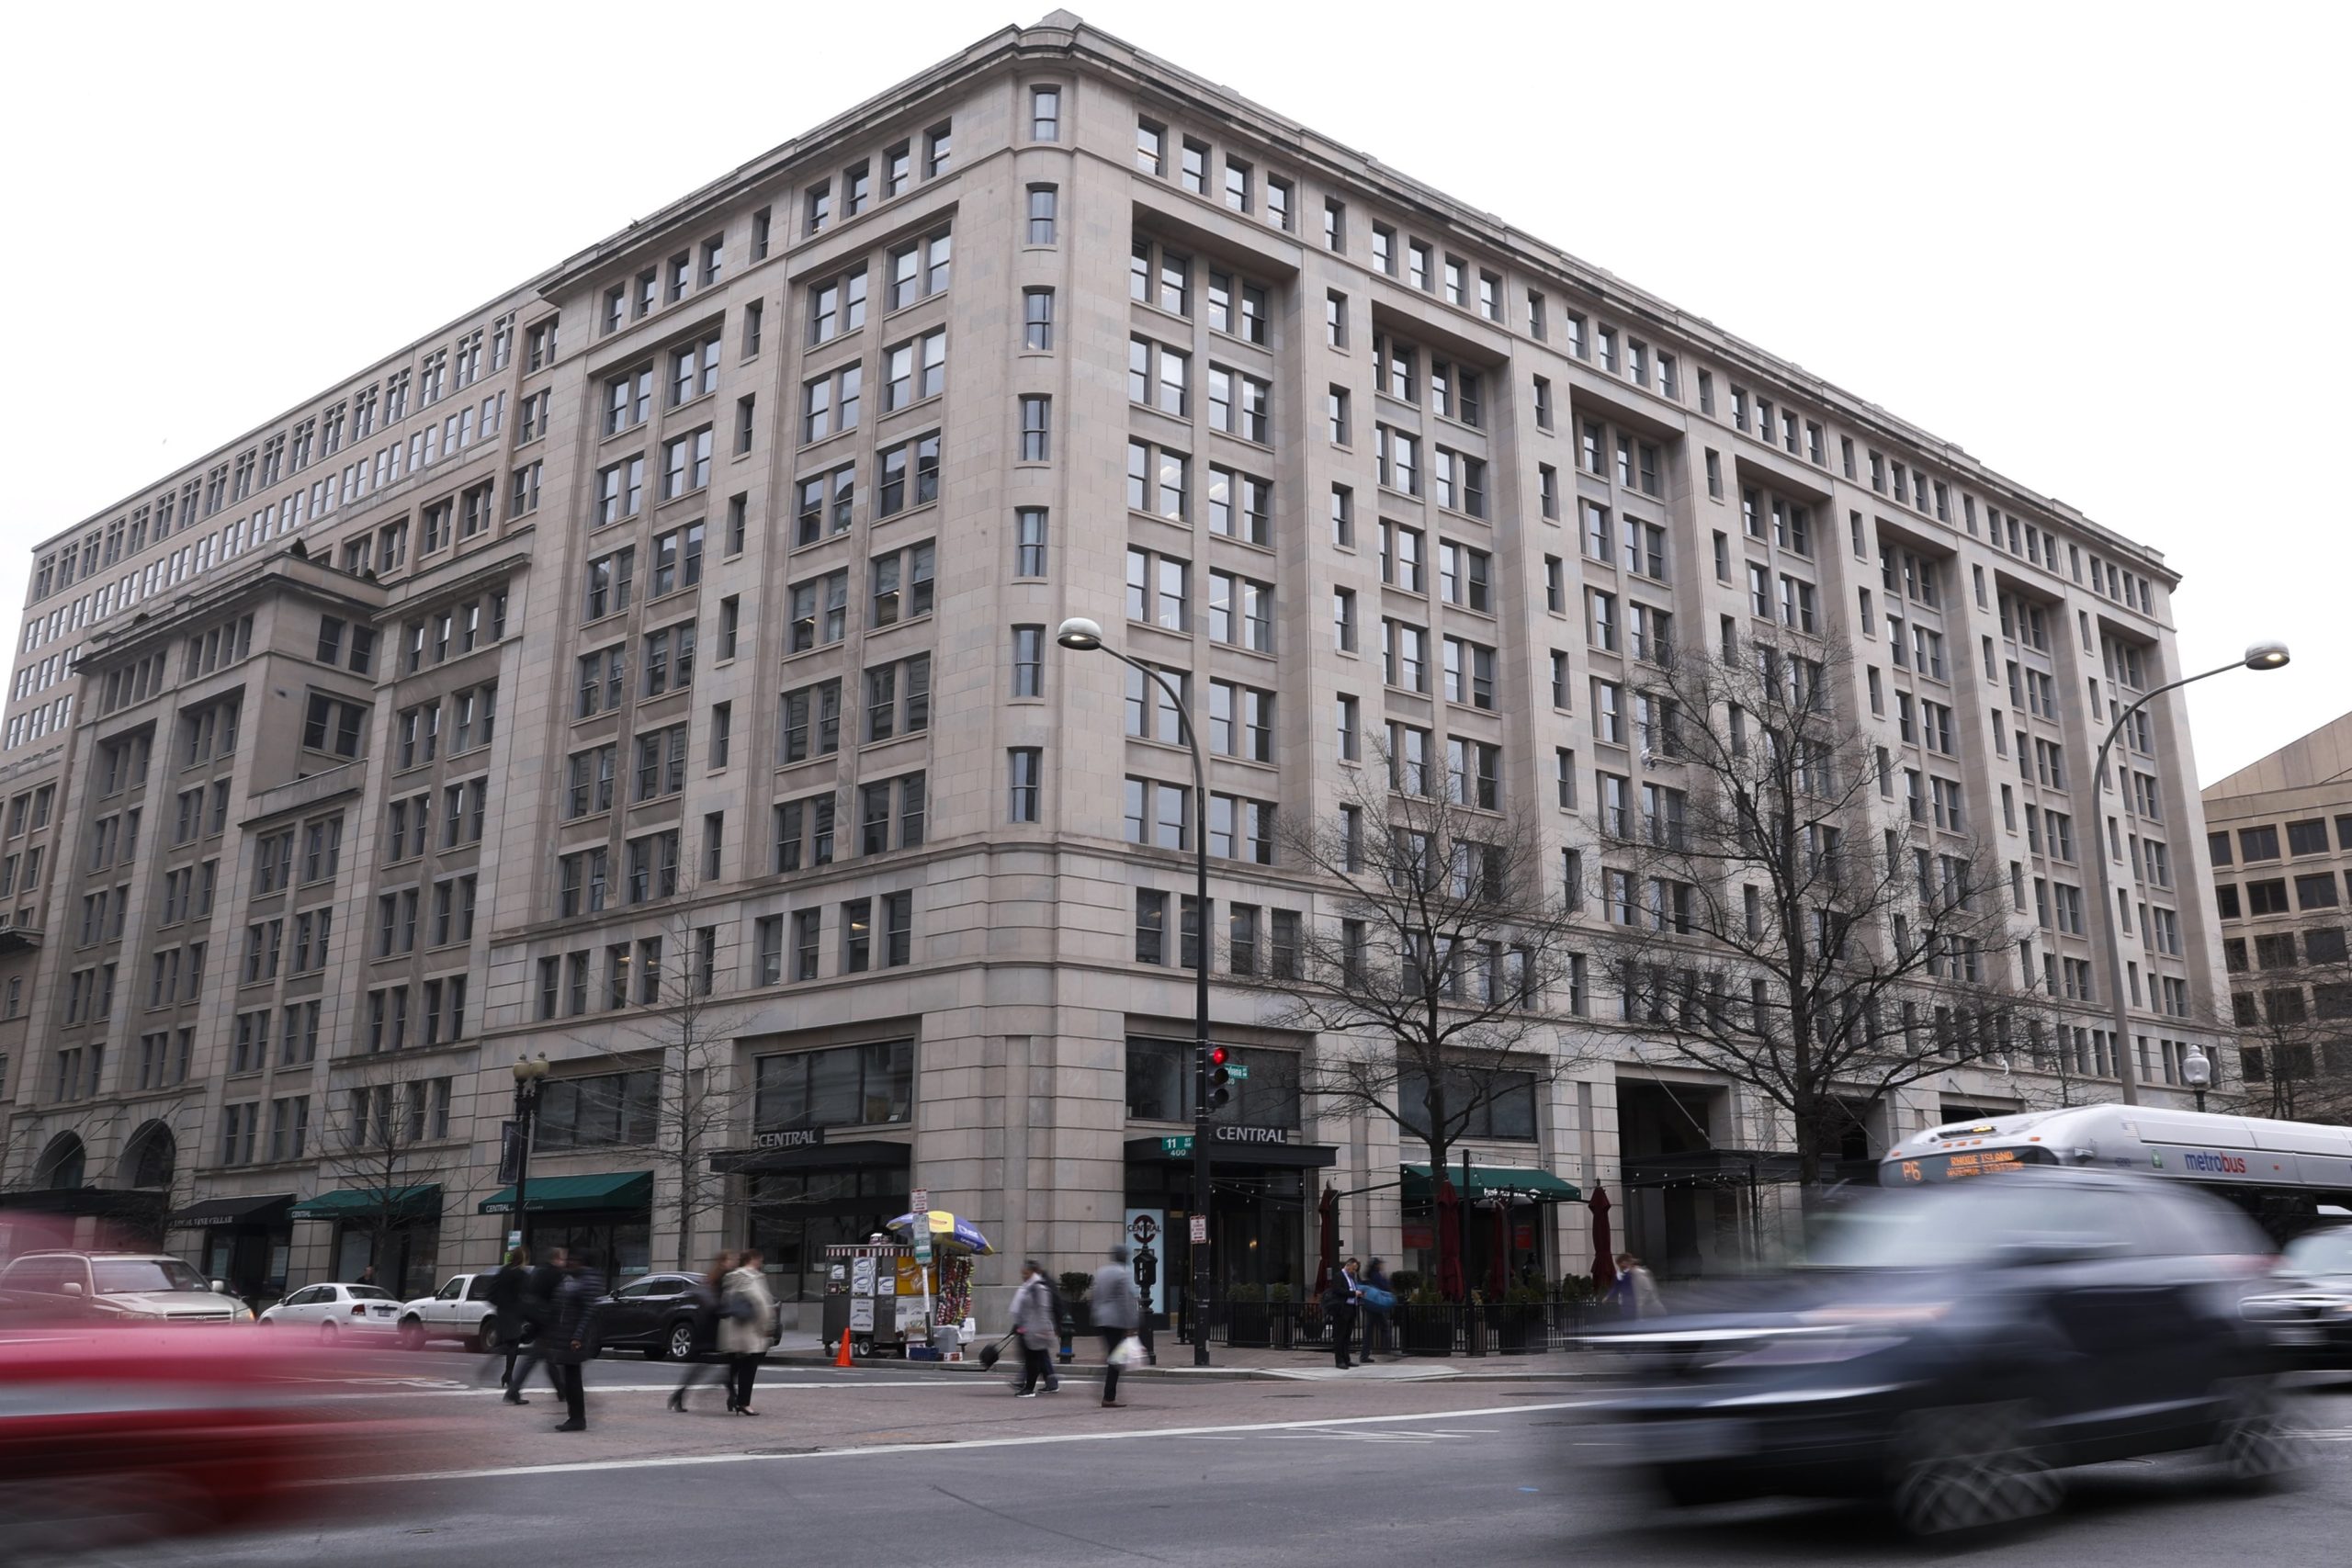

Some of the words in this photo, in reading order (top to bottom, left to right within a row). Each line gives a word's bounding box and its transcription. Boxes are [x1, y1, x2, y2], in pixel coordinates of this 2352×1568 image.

[759, 1130, 817, 1147] CENTRAL
[1167, 1138, 1176, 1148] 11
[1216, 1126, 1285, 1144] CENTRAL
[1170, 1148, 1186, 1156] 400
[1951, 1154, 1978, 1167] RHODE
[1980, 1150, 2015, 1164] ISLAND
[1902, 1161, 1922, 1181] P6
[2184, 1151, 2246, 1174] metrobus
[485, 1203, 510, 1213] CENTRAL
[1126, 1224, 1162, 1234] CENRAL
